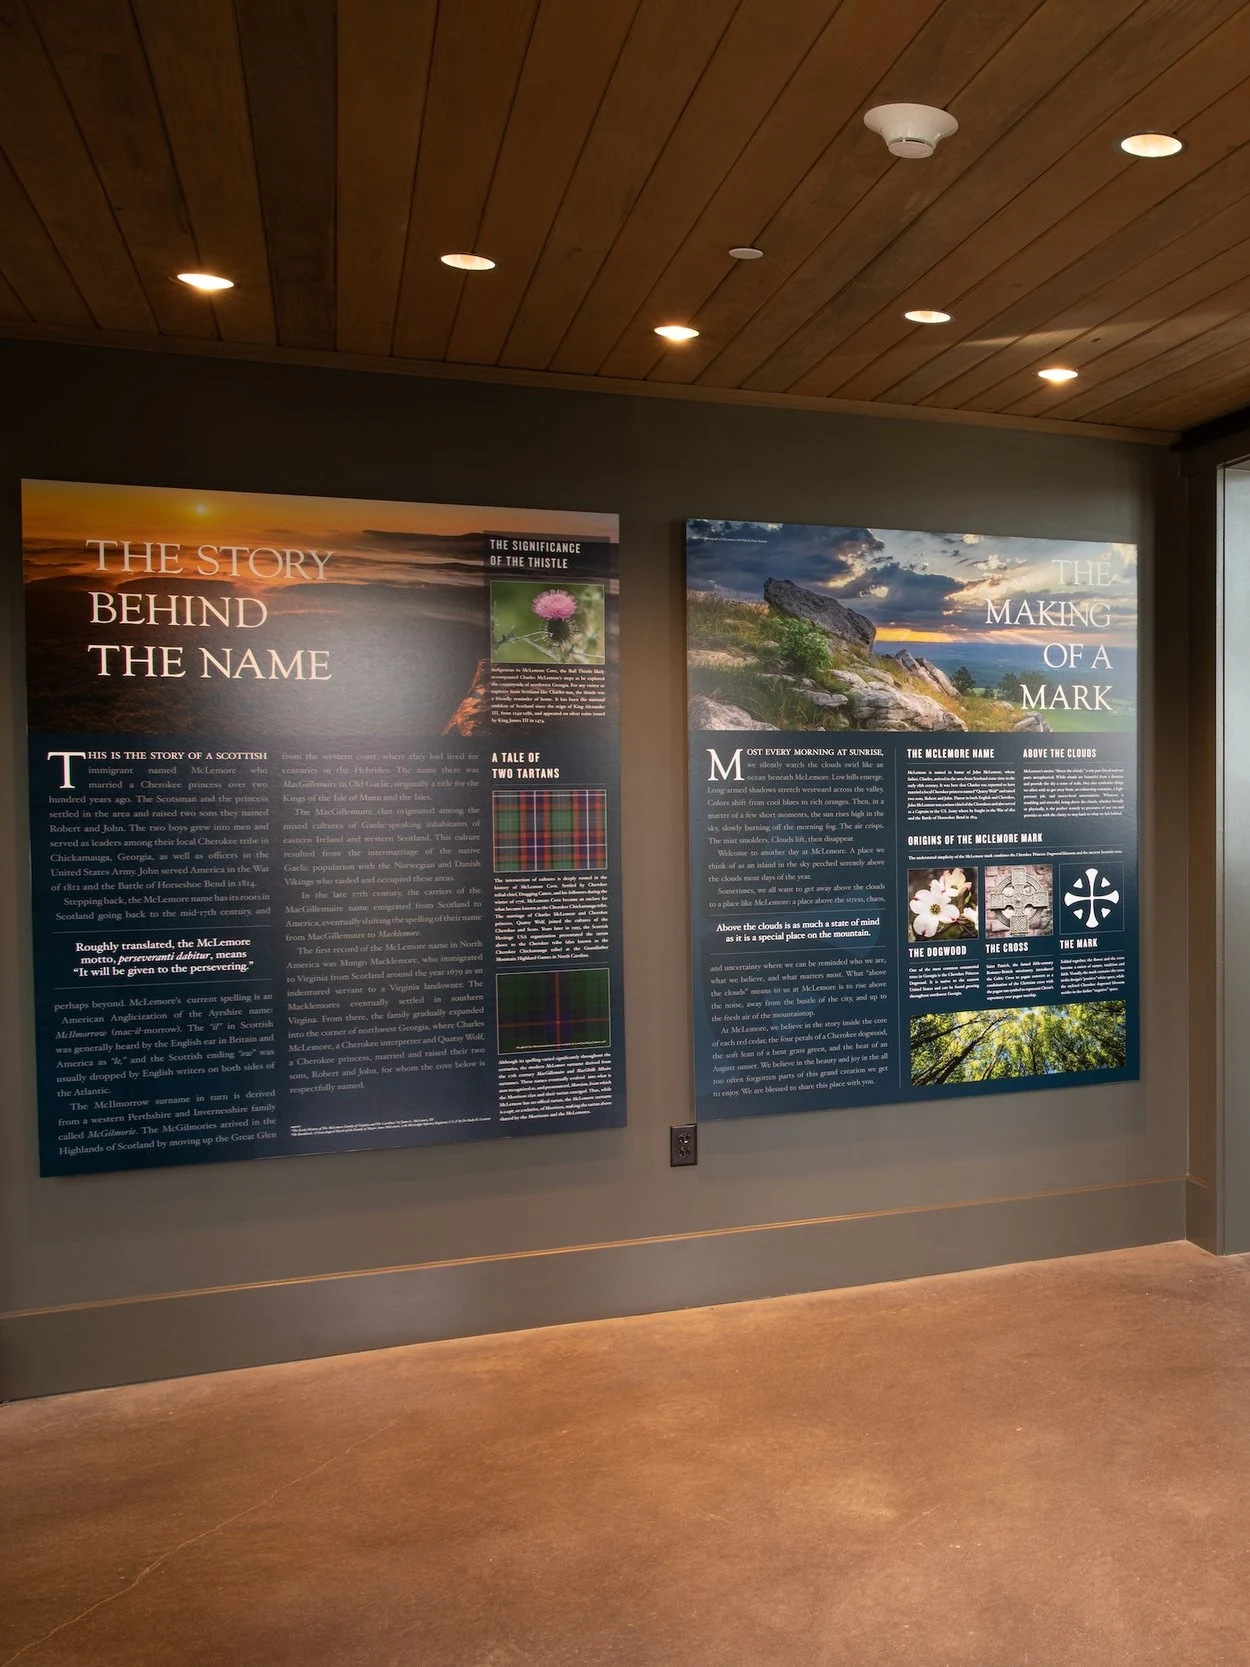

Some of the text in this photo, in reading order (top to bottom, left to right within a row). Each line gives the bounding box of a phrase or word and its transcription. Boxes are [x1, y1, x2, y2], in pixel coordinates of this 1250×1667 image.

[489, 539, 580, 554] THE SIGNIFICANCE
[86, 539, 334, 580] THE STORY
[490, 555, 568, 569] OF THE THISTLE
[1051, 558, 1113, 586] THE
[88, 591, 267, 628] BEHIND
[983, 596, 1111, 627] MAKING
[87, 644, 332, 680] THE NAME
[1041, 641, 1113, 669] OF A
[1019, 684, 1112, 712] MARK
[111, 751, 121, 759] IS
[123, 751, 147, 759] THE
[150, 751, 185, 759] STORY
[187, 751, 203, 759] OF
[215, 751, 267, 760] SCOTTISH
[491, 752, 540, 763] A TALE OF
[793, 748, 834, 756] MORNING
[836, 748, 848, 756] AT
[849, 748, 884, 756] SUNRISE,
[906, 748, 994, 758] THE MCLEMORE NAME
[1022, 748, 1096, 758] ABOVE THE CLOUDS
[88, 766, 268, 776] immigrant named McLemore who
[491, 768, 559, 779] TWO TARTANS
[48, 795, 86, 803] hundred
[88, 797, 112, 805] years
[135, 794, 153, 803] The
[155, 794, 197, 803] Scotsman
[199, 794, 215, 802] and
[218, 794, 232, 802] the
[234, 795, 269, 804] princess
[907, 832, 1042, 846] ORIGINS OF THE MCLEMORE MARK
[717, 849, 748, 857] Welcome
[760, 848, 786, 856] another
[787, 848, 799, 857] day
[857, 846, 873, 855] place
[716, 923, 741, 932] Above
[743, 922, 756, 930] the
[757, 921, 783, 930] clouds
[784, 921, 791, 929] is
[802, 919, 823, 928] much
[850, 917, 860, 926] of
[860, 917, 880, 926] mind
[735, 934, 742, 942] it
[743, 933, 750, 941] is
[758, 931, 784, 943] special
[785, 931, 806, 942] place
[818, 930, 832, 938] the
[833, 928, 871, 937] mountain.
[75, 937, 251, 954] Roughly translated, the McLemore
[985, 941, 1028, 953] THE CROSS
[1059, 938, 1097, 949] THE MARK
[80, 952, 116, 964] motto,
[116, 951, 175, 965] perseveranti
[175, 950, 213, 965] dabitur,
[908, 945, 966, 958] THE DOGWOOD
[90, 966, 110, 976] will
[112, 964, 125, 975] be
[127, 965, 155, 977] given
[170, 963, 188, 973] the
[796, 996, 816, 1005] bustle
[817, 995, 826, 1003] of
[827, 995, 838, 1003] the
[855, 993, 867, 1001] and
